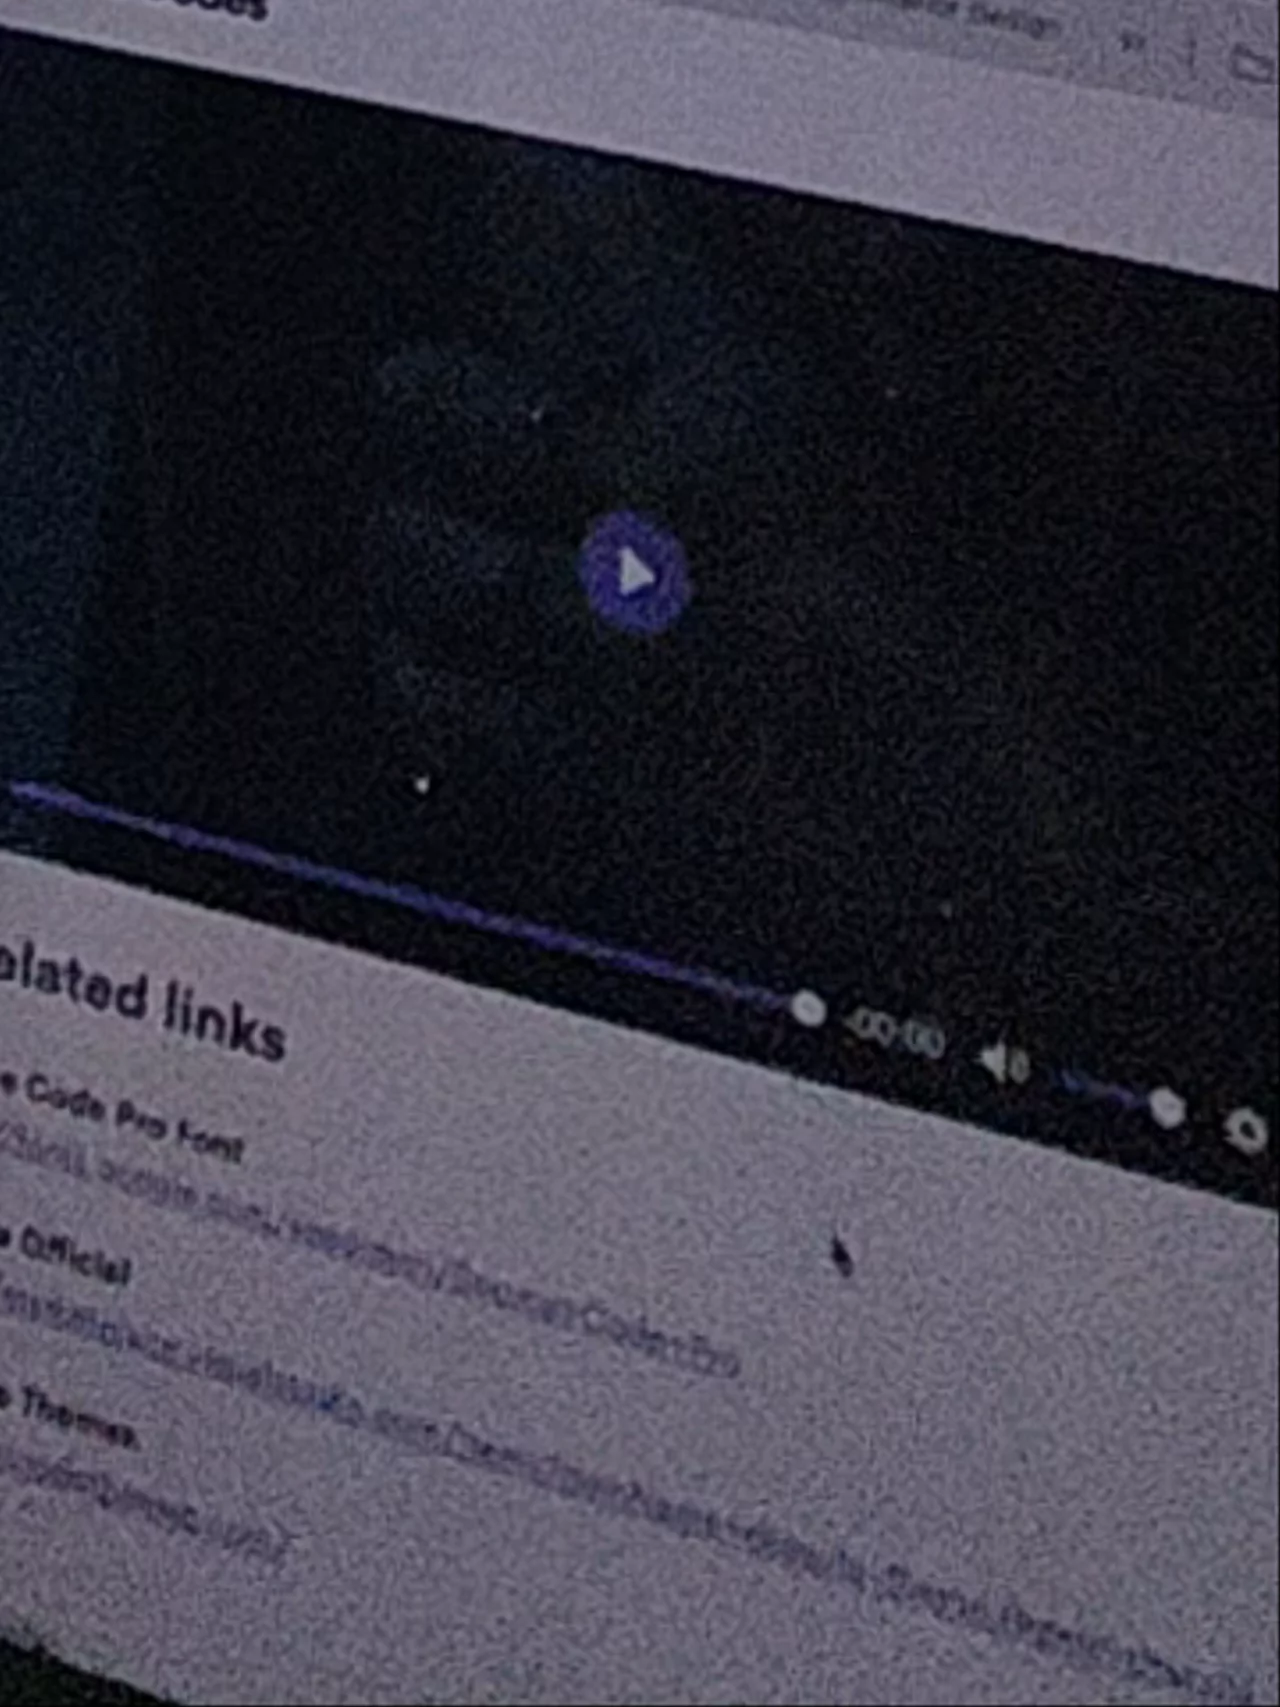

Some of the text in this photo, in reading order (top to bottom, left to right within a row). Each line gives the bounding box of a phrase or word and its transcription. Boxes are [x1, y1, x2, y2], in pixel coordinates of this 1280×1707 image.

[162, 978, 286, 1063] links
[25, 1072, 106, 1122] Code
[114, 1098, 168, 1141] Pro
[20, 1224, 133, 1287] Official
